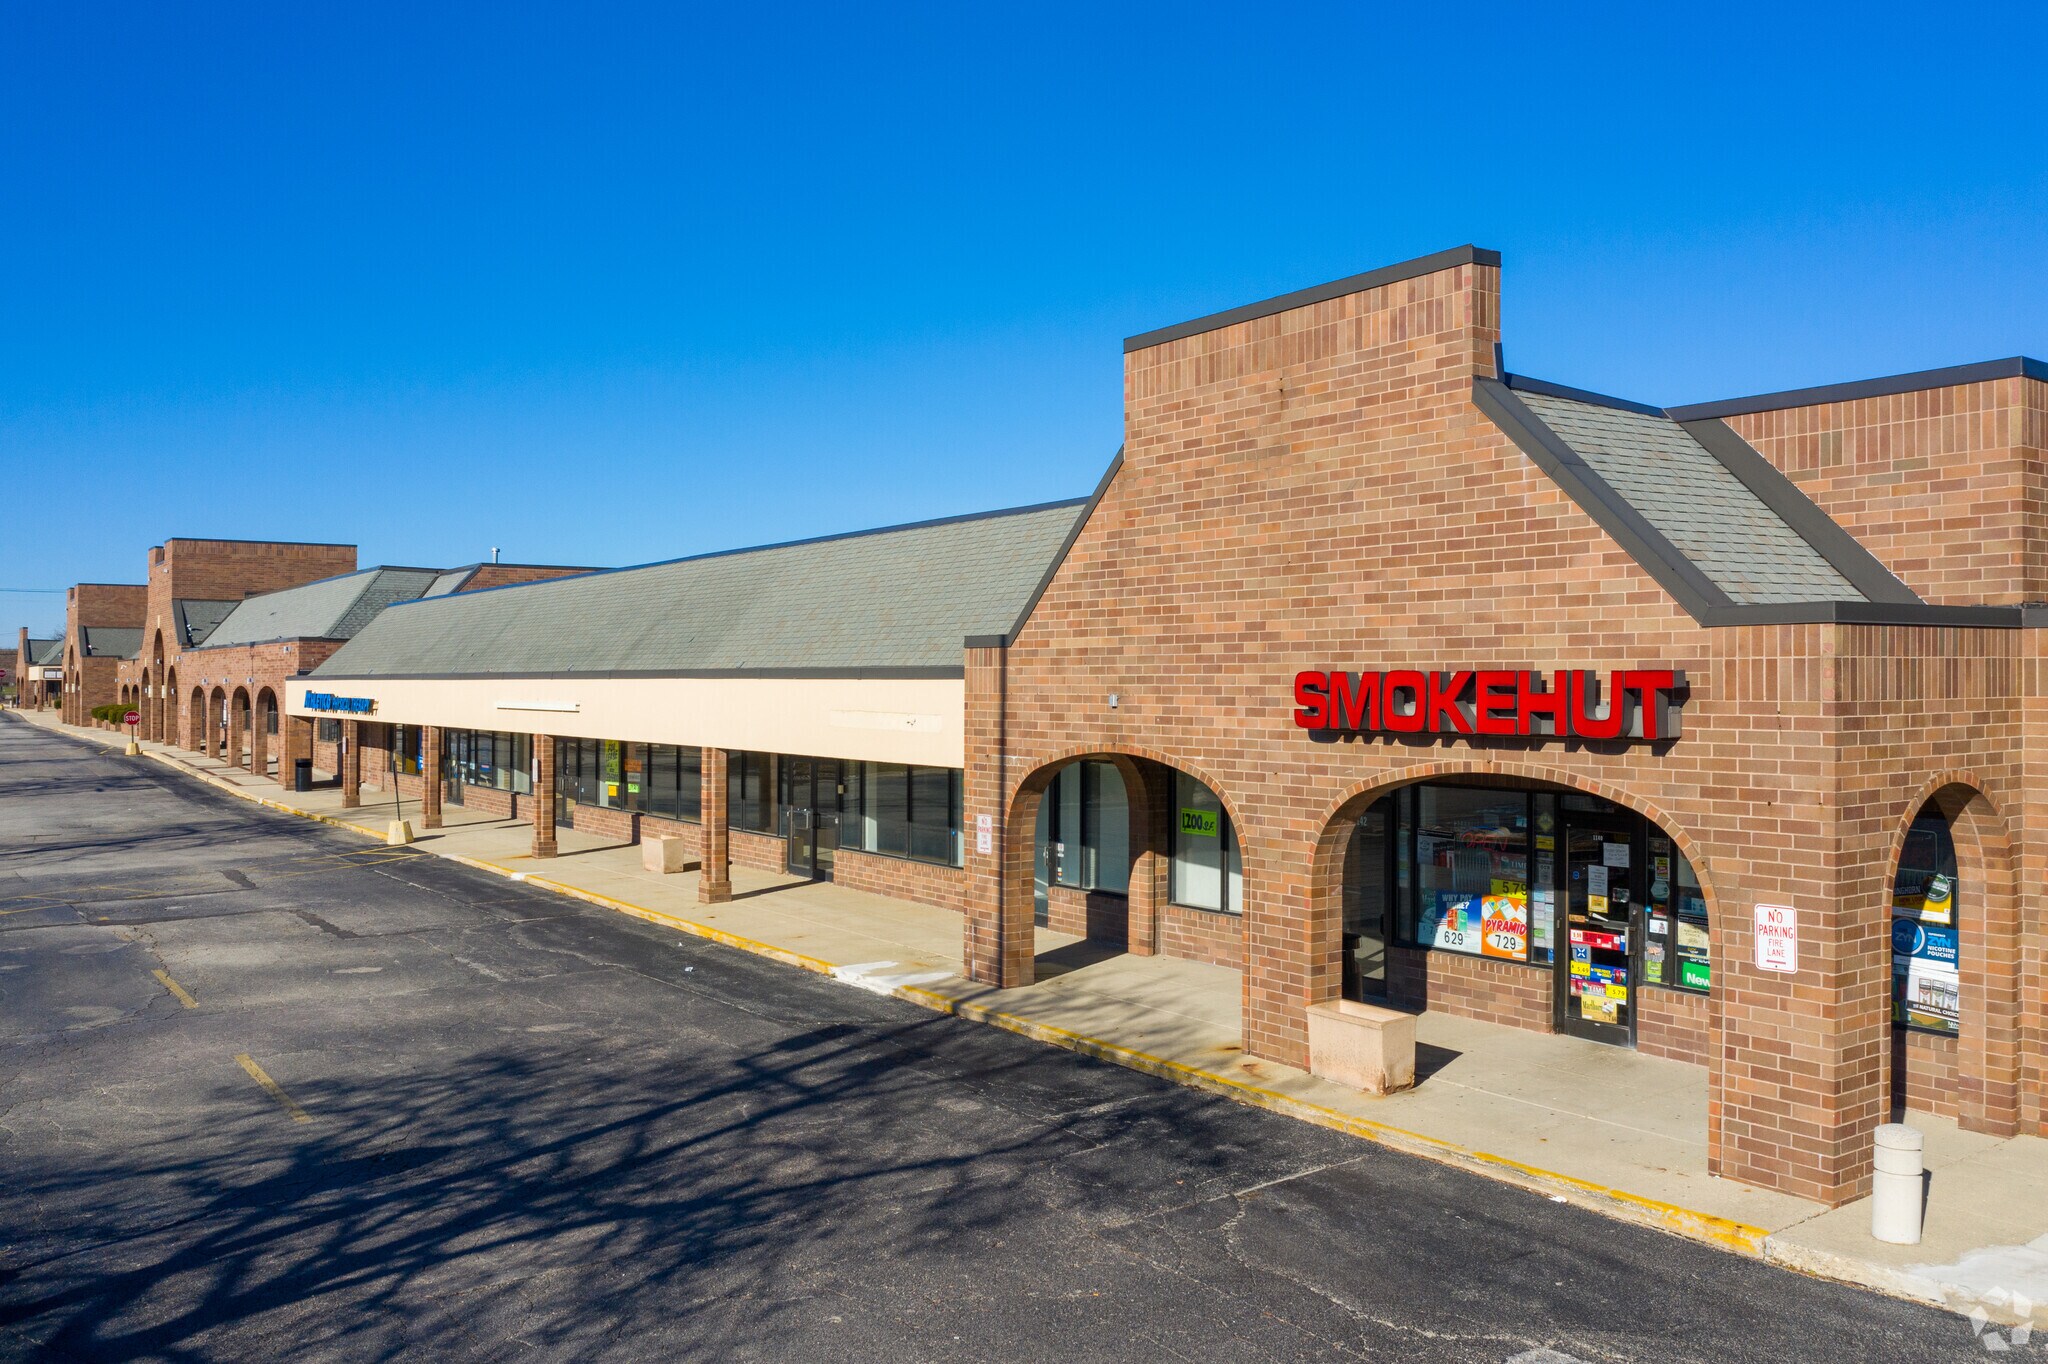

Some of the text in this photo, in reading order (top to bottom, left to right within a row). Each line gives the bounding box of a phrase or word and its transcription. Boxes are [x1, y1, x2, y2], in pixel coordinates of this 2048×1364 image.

[1294, 669, 1678, 740] SMOKEHUT
[1461, 832, 1508, 851] OPEN
[1442, 894, 1457, 902] WHY
[1460, 894, 1473, 902] PAY
[1447, 901, 1470, 909] MORE?
[1768, 911, 1783, 923] NO
[1485, 920, 1527, 936] PYRAMID
[1759, 924, 1793, 939] PARKING
[1768, 938, 1783, 948] FIRE
[1895, 932, 1916, 943] ZYN
[1928, 936, 1951, 948] ZYN
[1767, 948, 1785, 958] LANE
[1927, 945, 1956, 955] NICOTINE
[1927, 951, 1954, 959] POUCHES
[1919, 1005, 1942, 1014] NATURAL
[1942, 1010, 1959, 1018] CHOIC
